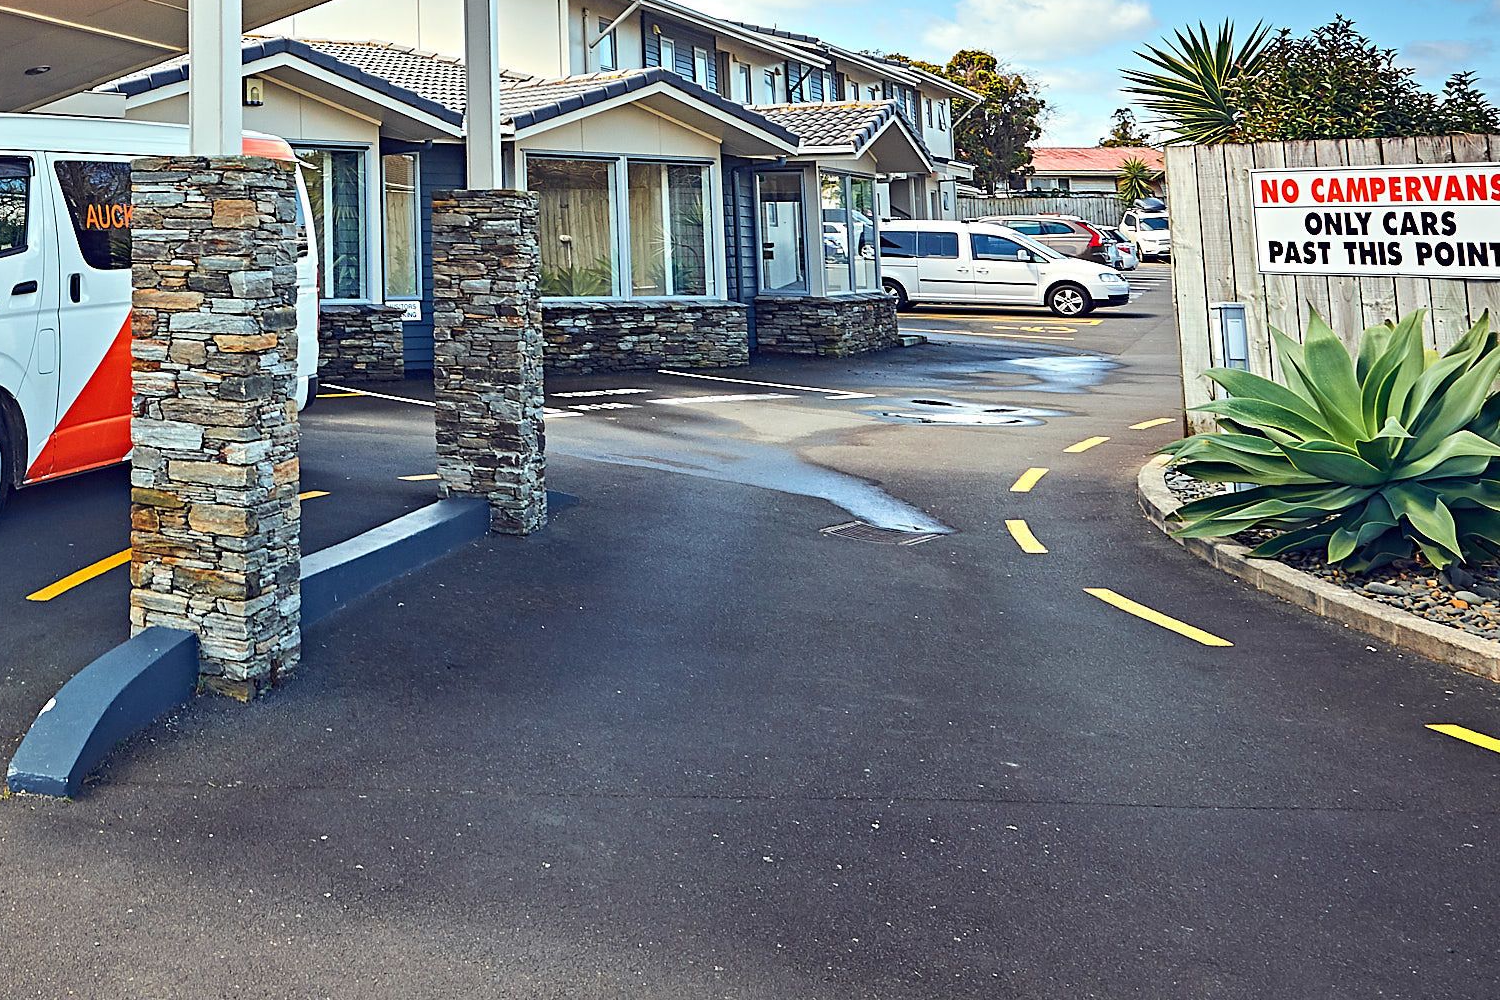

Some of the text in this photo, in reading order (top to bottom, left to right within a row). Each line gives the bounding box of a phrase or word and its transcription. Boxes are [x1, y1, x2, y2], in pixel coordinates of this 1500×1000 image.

[1261, 174, 1500, 203] NO CAMPERVANS
[1304, 211, 1457, 236] ONLY CARS
[1268, 240, 1500, 267] PAST THIS POINT
